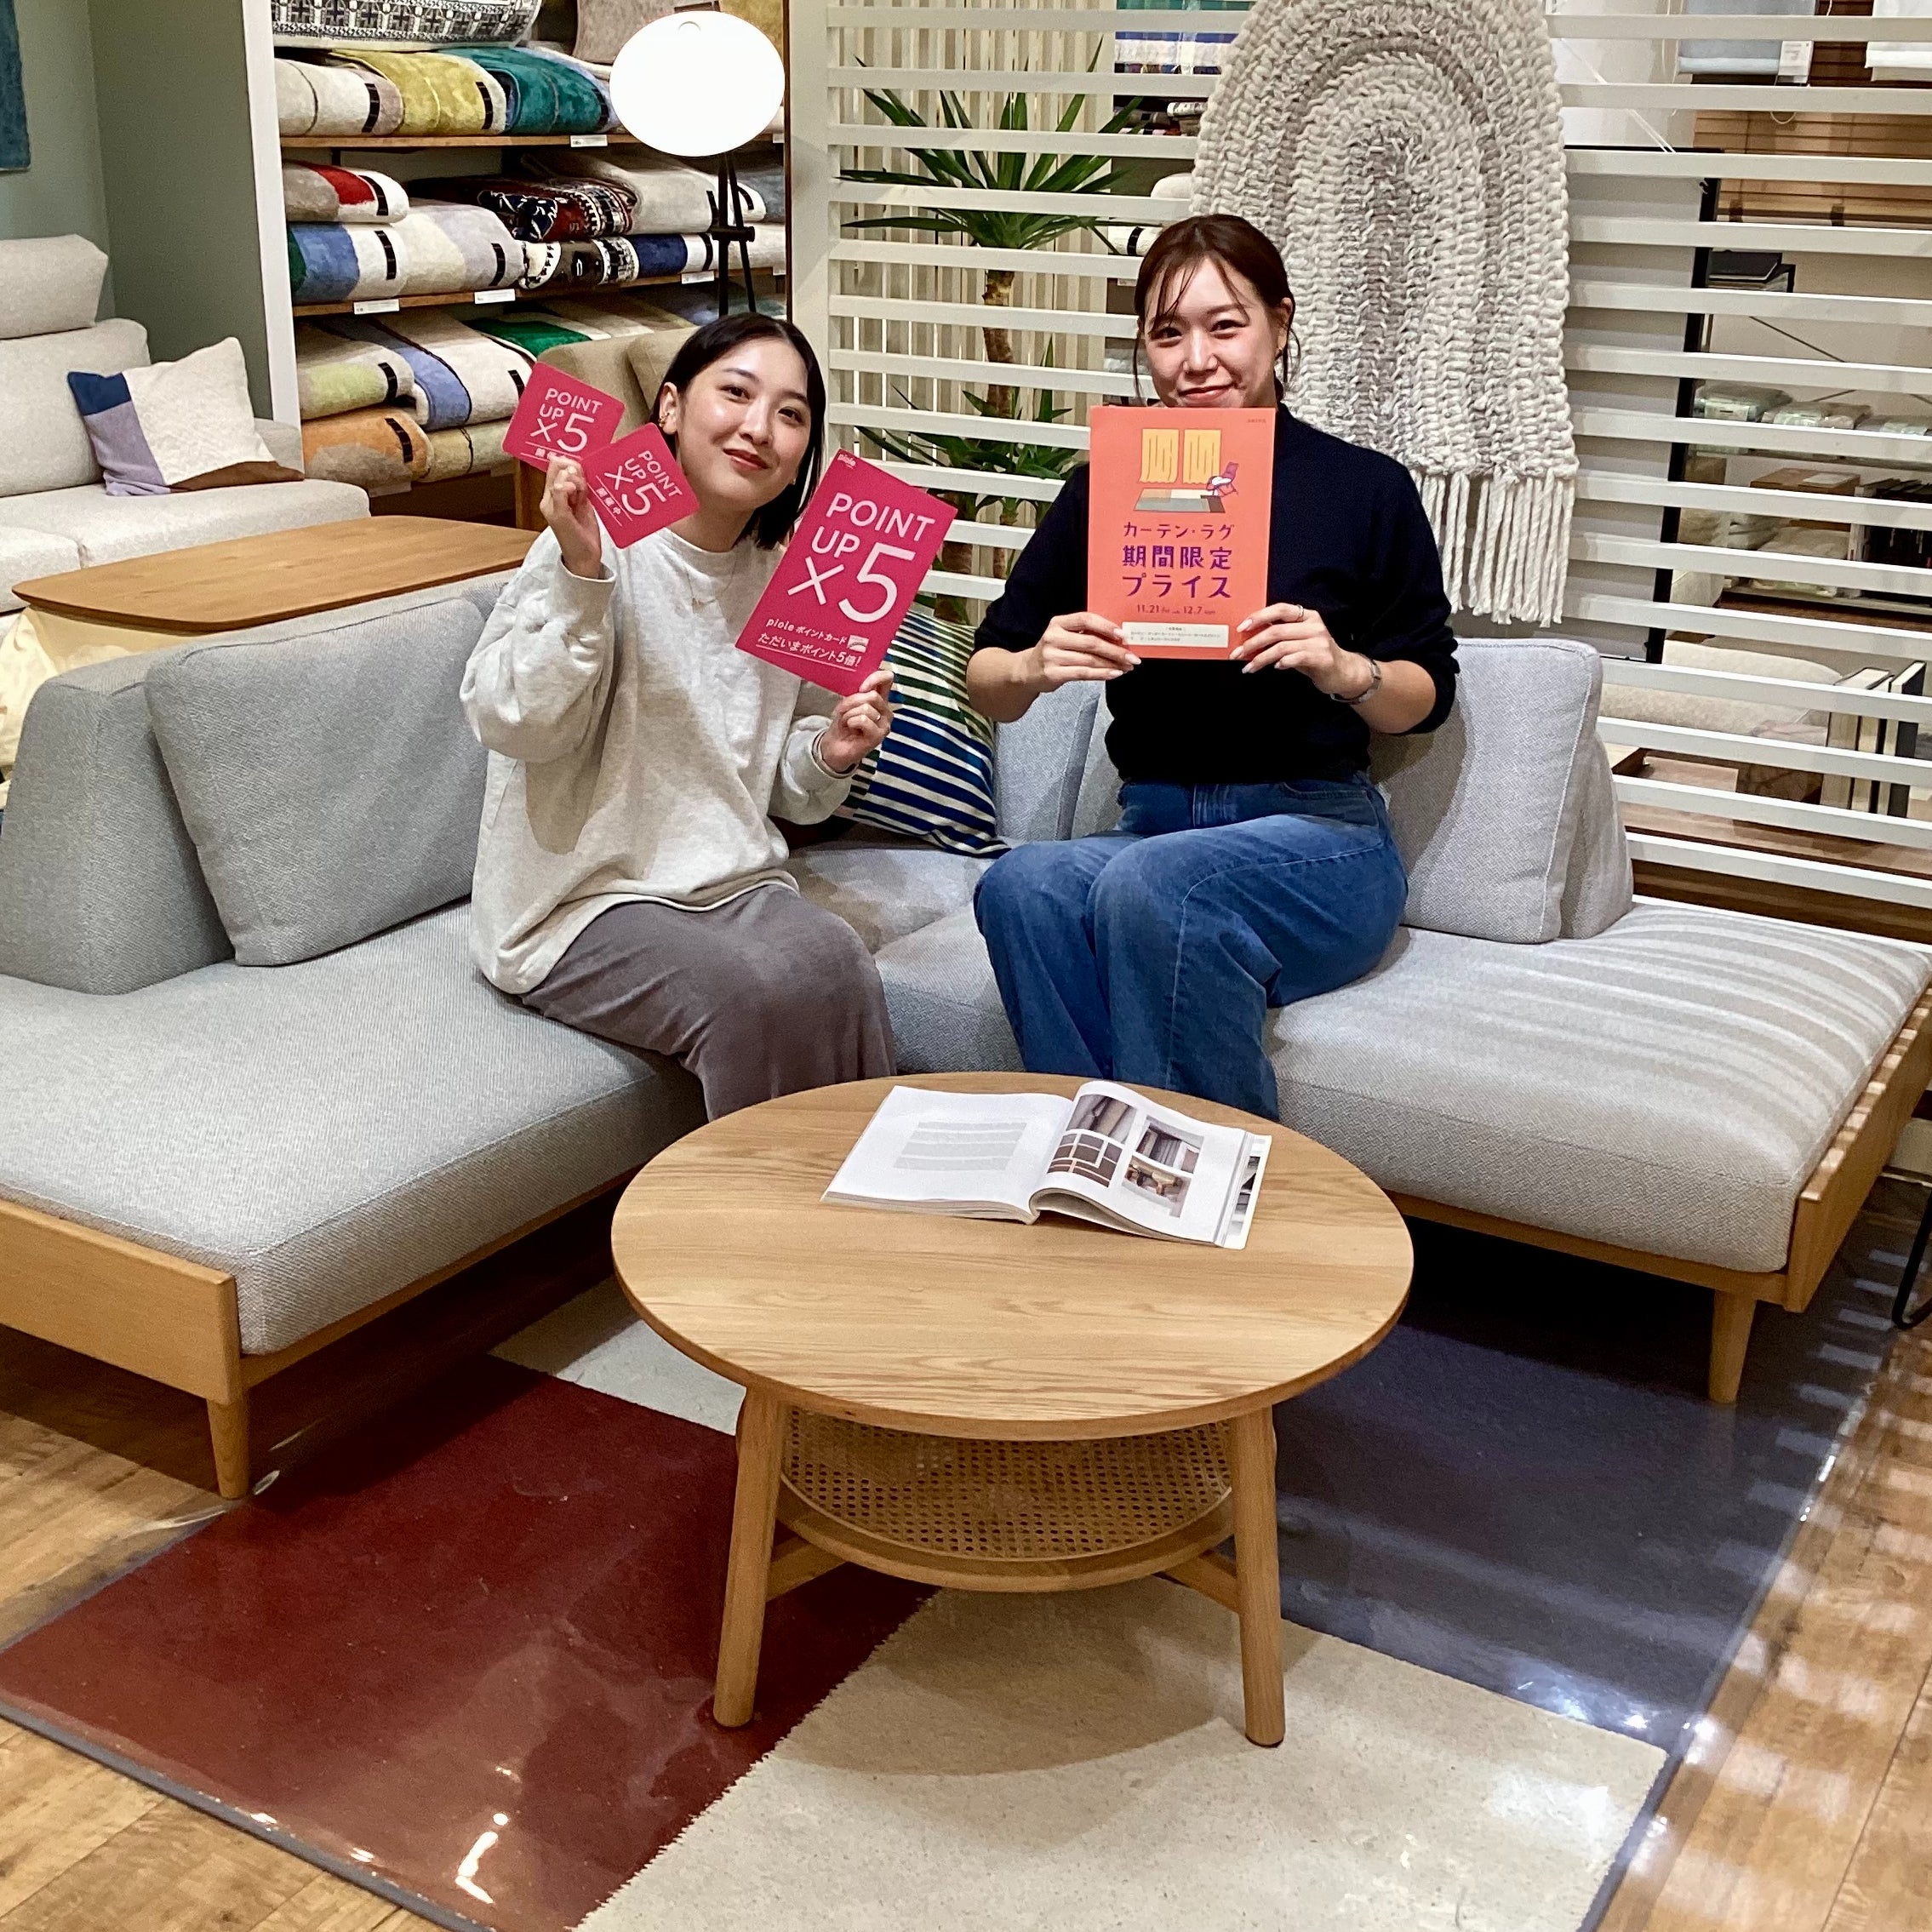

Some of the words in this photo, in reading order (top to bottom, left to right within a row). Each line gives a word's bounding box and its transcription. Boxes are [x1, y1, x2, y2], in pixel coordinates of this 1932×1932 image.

[540, 403, 565, 420] UP
[545, 388, 603, 414] POINT
[624, 458, 647, 480] UP
[638, 450, 683, 497] POINT
[826, 492, 935, 542] POINT
[811, 526, 860, 558] UP
[1123, 521, 1235, 540] カーテン・ラグ
[1122, 545, 1232, 570] 期間限定
[1122, 573, 1232, 598] プライス
[766, 618, 795, 632] piole
[796, 626, 848, 644] ポイントカード
